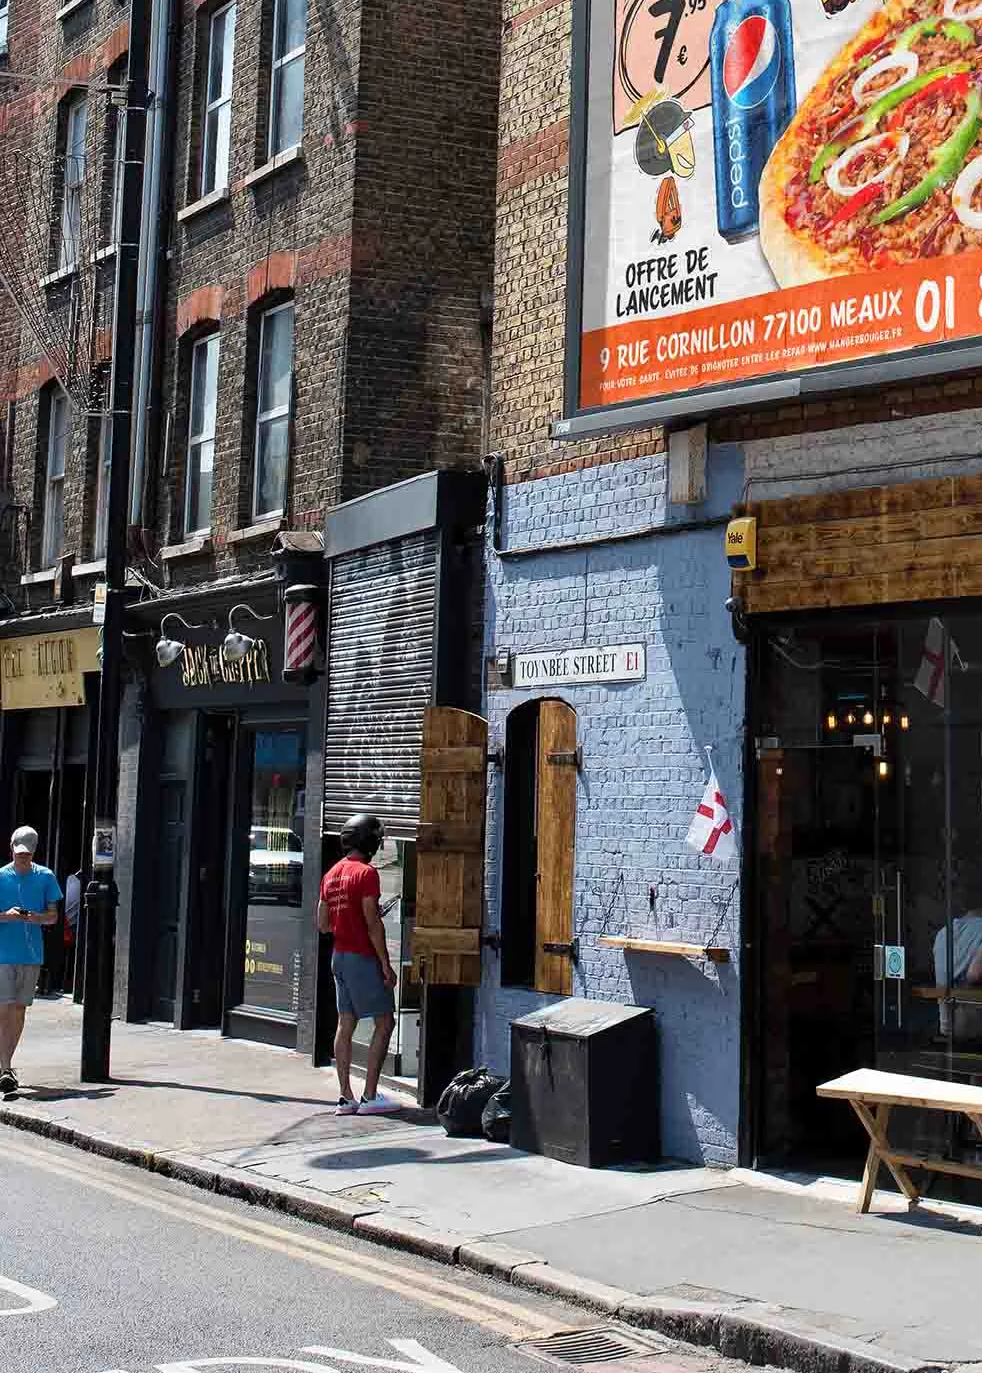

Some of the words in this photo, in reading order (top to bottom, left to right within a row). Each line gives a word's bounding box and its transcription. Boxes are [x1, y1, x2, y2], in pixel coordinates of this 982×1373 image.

[727, 118, 748, 208] pepsi
[626, 254, 678, 288] OFFRE
[685, 247, 709, 274] DE
[616, 273, 718, 318] LANCEMENT
[915, 276, 955, 333] 01
[600, 347, 610, 373] 9
[617, 340, 650, 369] RUE
[657, 319, 755, 362] CORNILLON
[763, 306, 822, 341] 77100
[830, 288, 903, 328] MEAUX
[728, 531, 744, 545] Yale
[520, 657, 569, 679] TOYNBEE
[573, 653, 617, 676] STREET
[626, 651, 639, 671] E1
